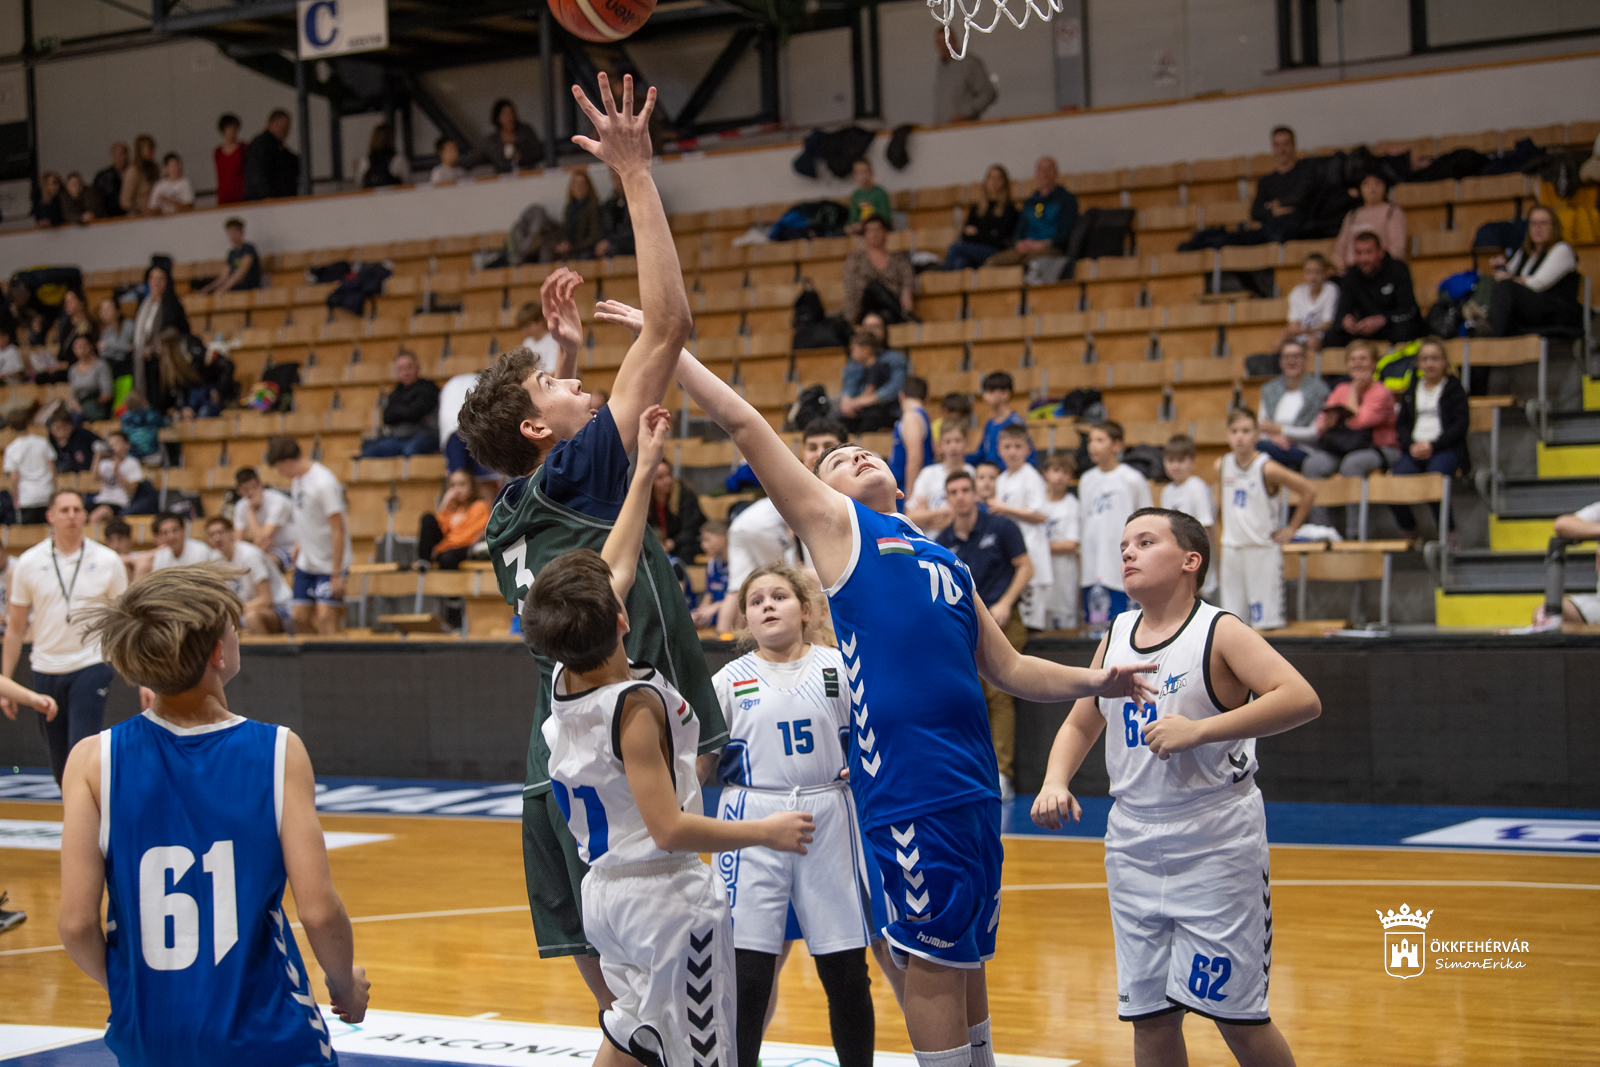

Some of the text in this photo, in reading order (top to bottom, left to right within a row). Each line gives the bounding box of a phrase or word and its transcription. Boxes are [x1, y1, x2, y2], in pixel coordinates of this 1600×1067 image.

[305, 1, 338, 48] C
[918, 560, 963, 606] 70
[1159, 678, 1187, 700] ALBA
[777, 719, 814, 756] 15
[1123, 702, 1157, 748] 62
[139, 840, 239, 971] 61
[916, 931, 957, 949] humme
[1189, 953, 1232, 1002] 62
[366, 1033, 599, 1059] ARCONIC
